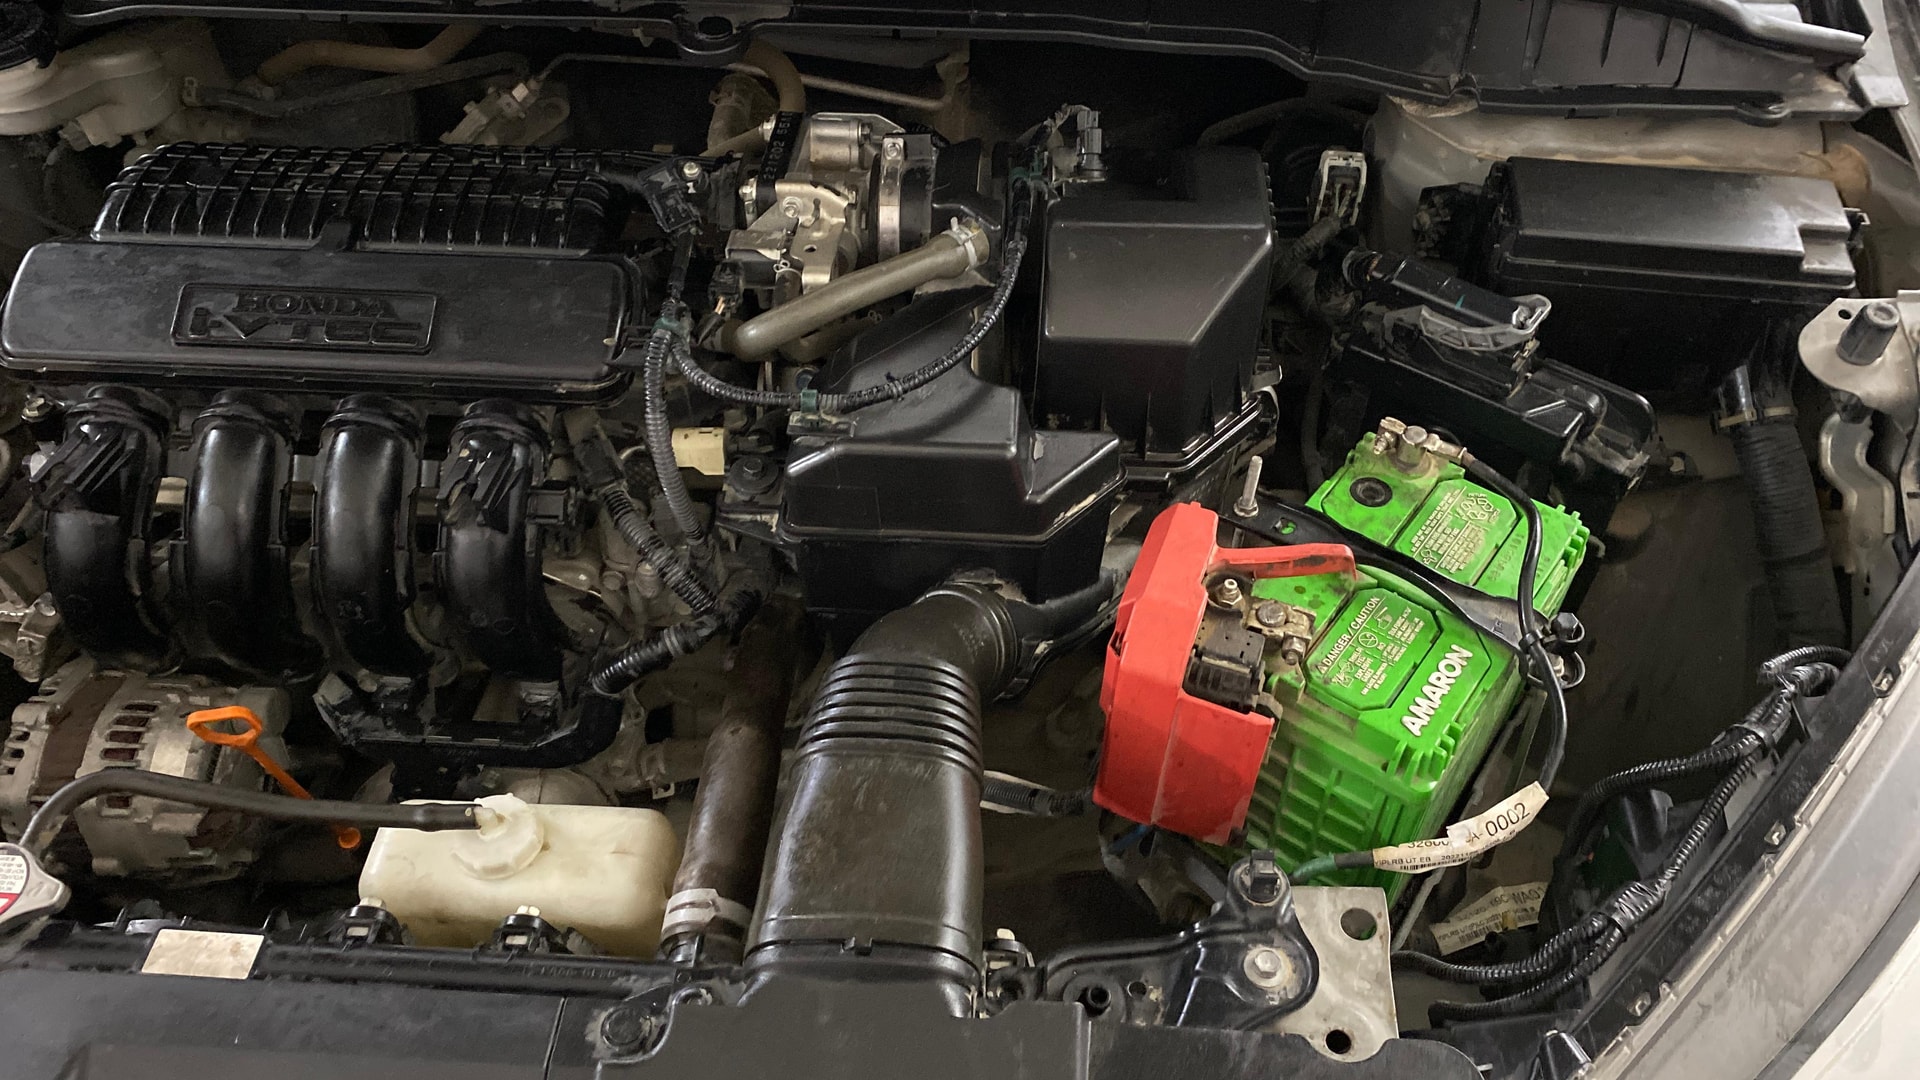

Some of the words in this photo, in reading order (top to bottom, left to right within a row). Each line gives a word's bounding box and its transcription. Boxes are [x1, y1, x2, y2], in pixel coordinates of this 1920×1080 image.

[232, 292, 400, 319] HONDA
[1322, 632, 1351, 666] DANGER
[1349, 596, 1380, 629] CAUTION
[1401, 644, 1473, 737] AMARON
[1485, 802, 1530, 838] 0002
